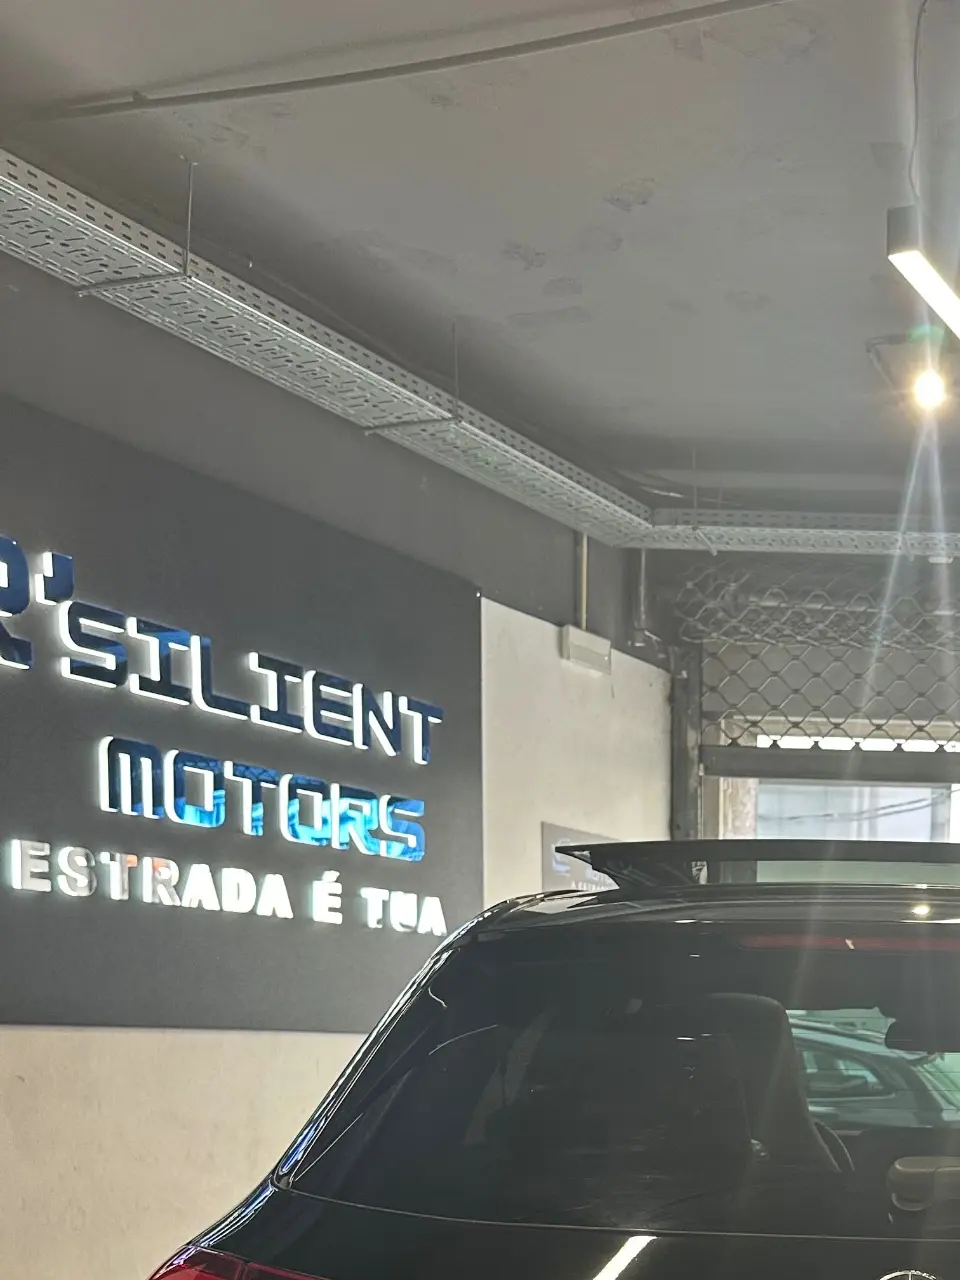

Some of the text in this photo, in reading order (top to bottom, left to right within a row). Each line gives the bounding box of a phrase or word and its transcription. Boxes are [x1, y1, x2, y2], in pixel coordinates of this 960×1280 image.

[99, 735, 426, 862] MOTORS
[10, 838, 447, 937] ESTRADA É TUA
